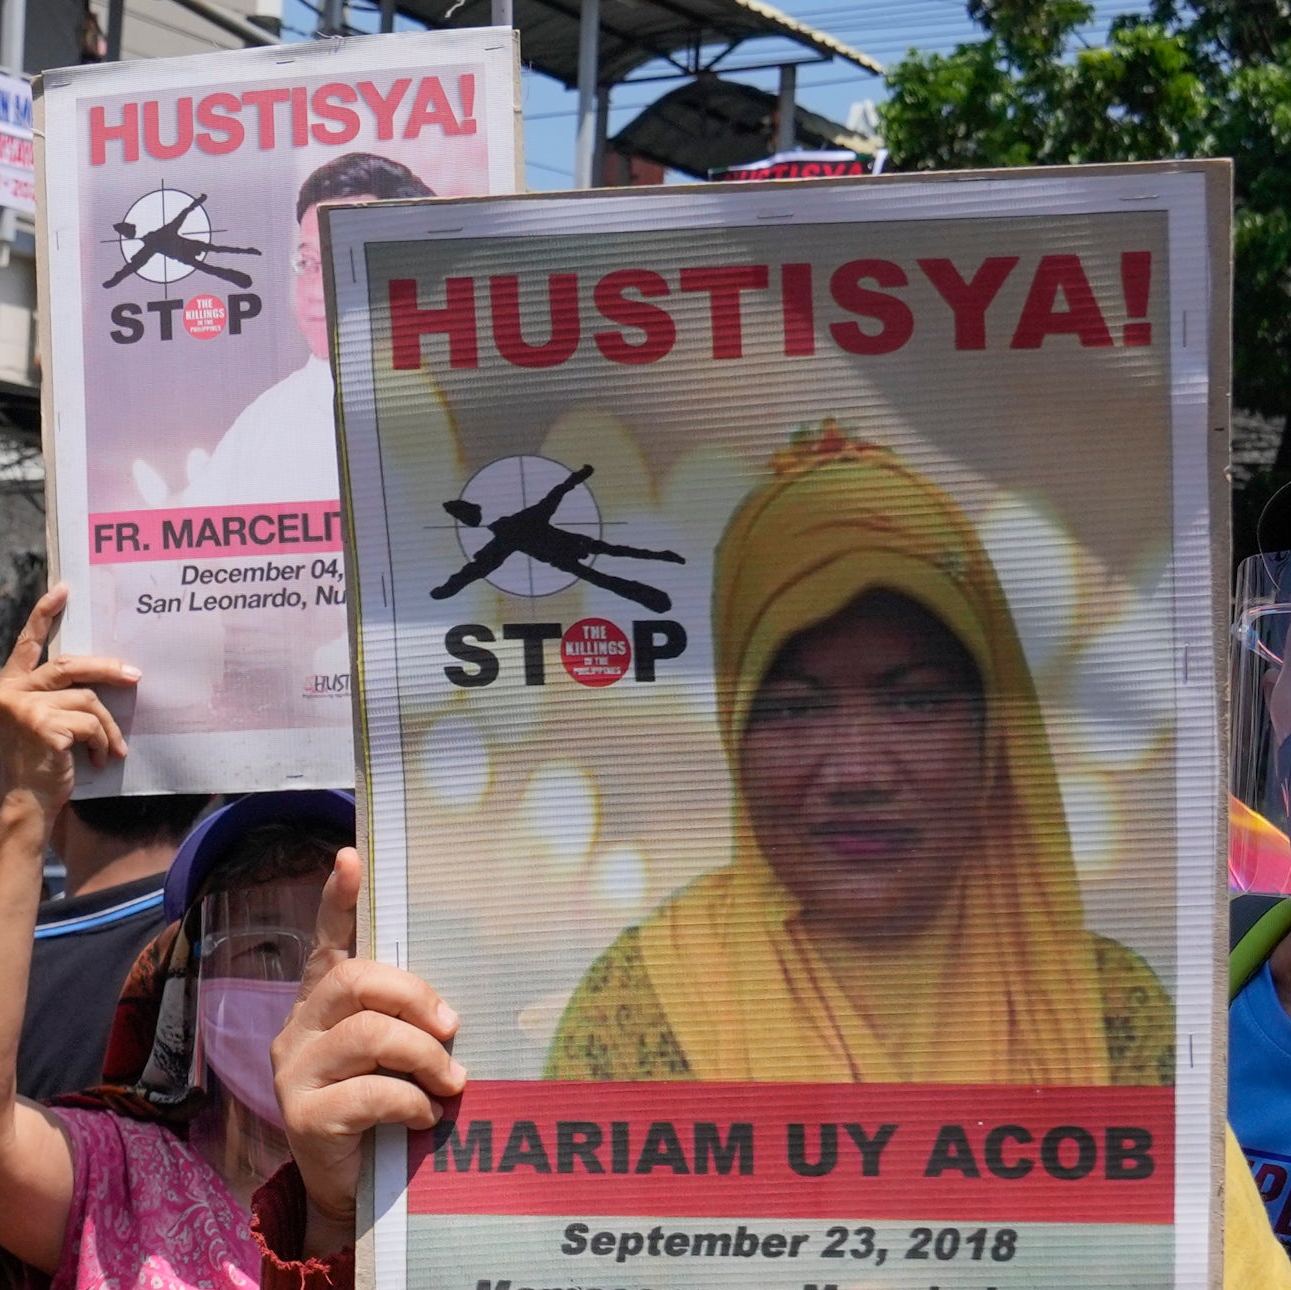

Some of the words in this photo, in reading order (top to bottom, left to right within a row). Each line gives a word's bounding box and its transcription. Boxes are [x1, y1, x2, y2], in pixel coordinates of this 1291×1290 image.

[90, 73, 478, 166] HUSTISYA!
[388, 250, 1153, 371] HUSTISYA!
[93, 521, 151, 553] FR.
[181, 561, 306, 586] December
[310, 557, 345, 585] 04,
[136, 592, 182, 615] San
[188, 587, 308, 613] Leonardo,
[565, 640, 627, 656] KILLINGS
[582, 625, 607, 640] THE
[431, 1118, 757, 1176] MARIAM
[786, 1122, 899, 1178] UY
[923, 1122, 1159, 1183] ACOB
[560, 1222, 809, 1263] September
[820, 1225, 889, 1267] 23,
[906, 1226, 1019, 1263] 2018
